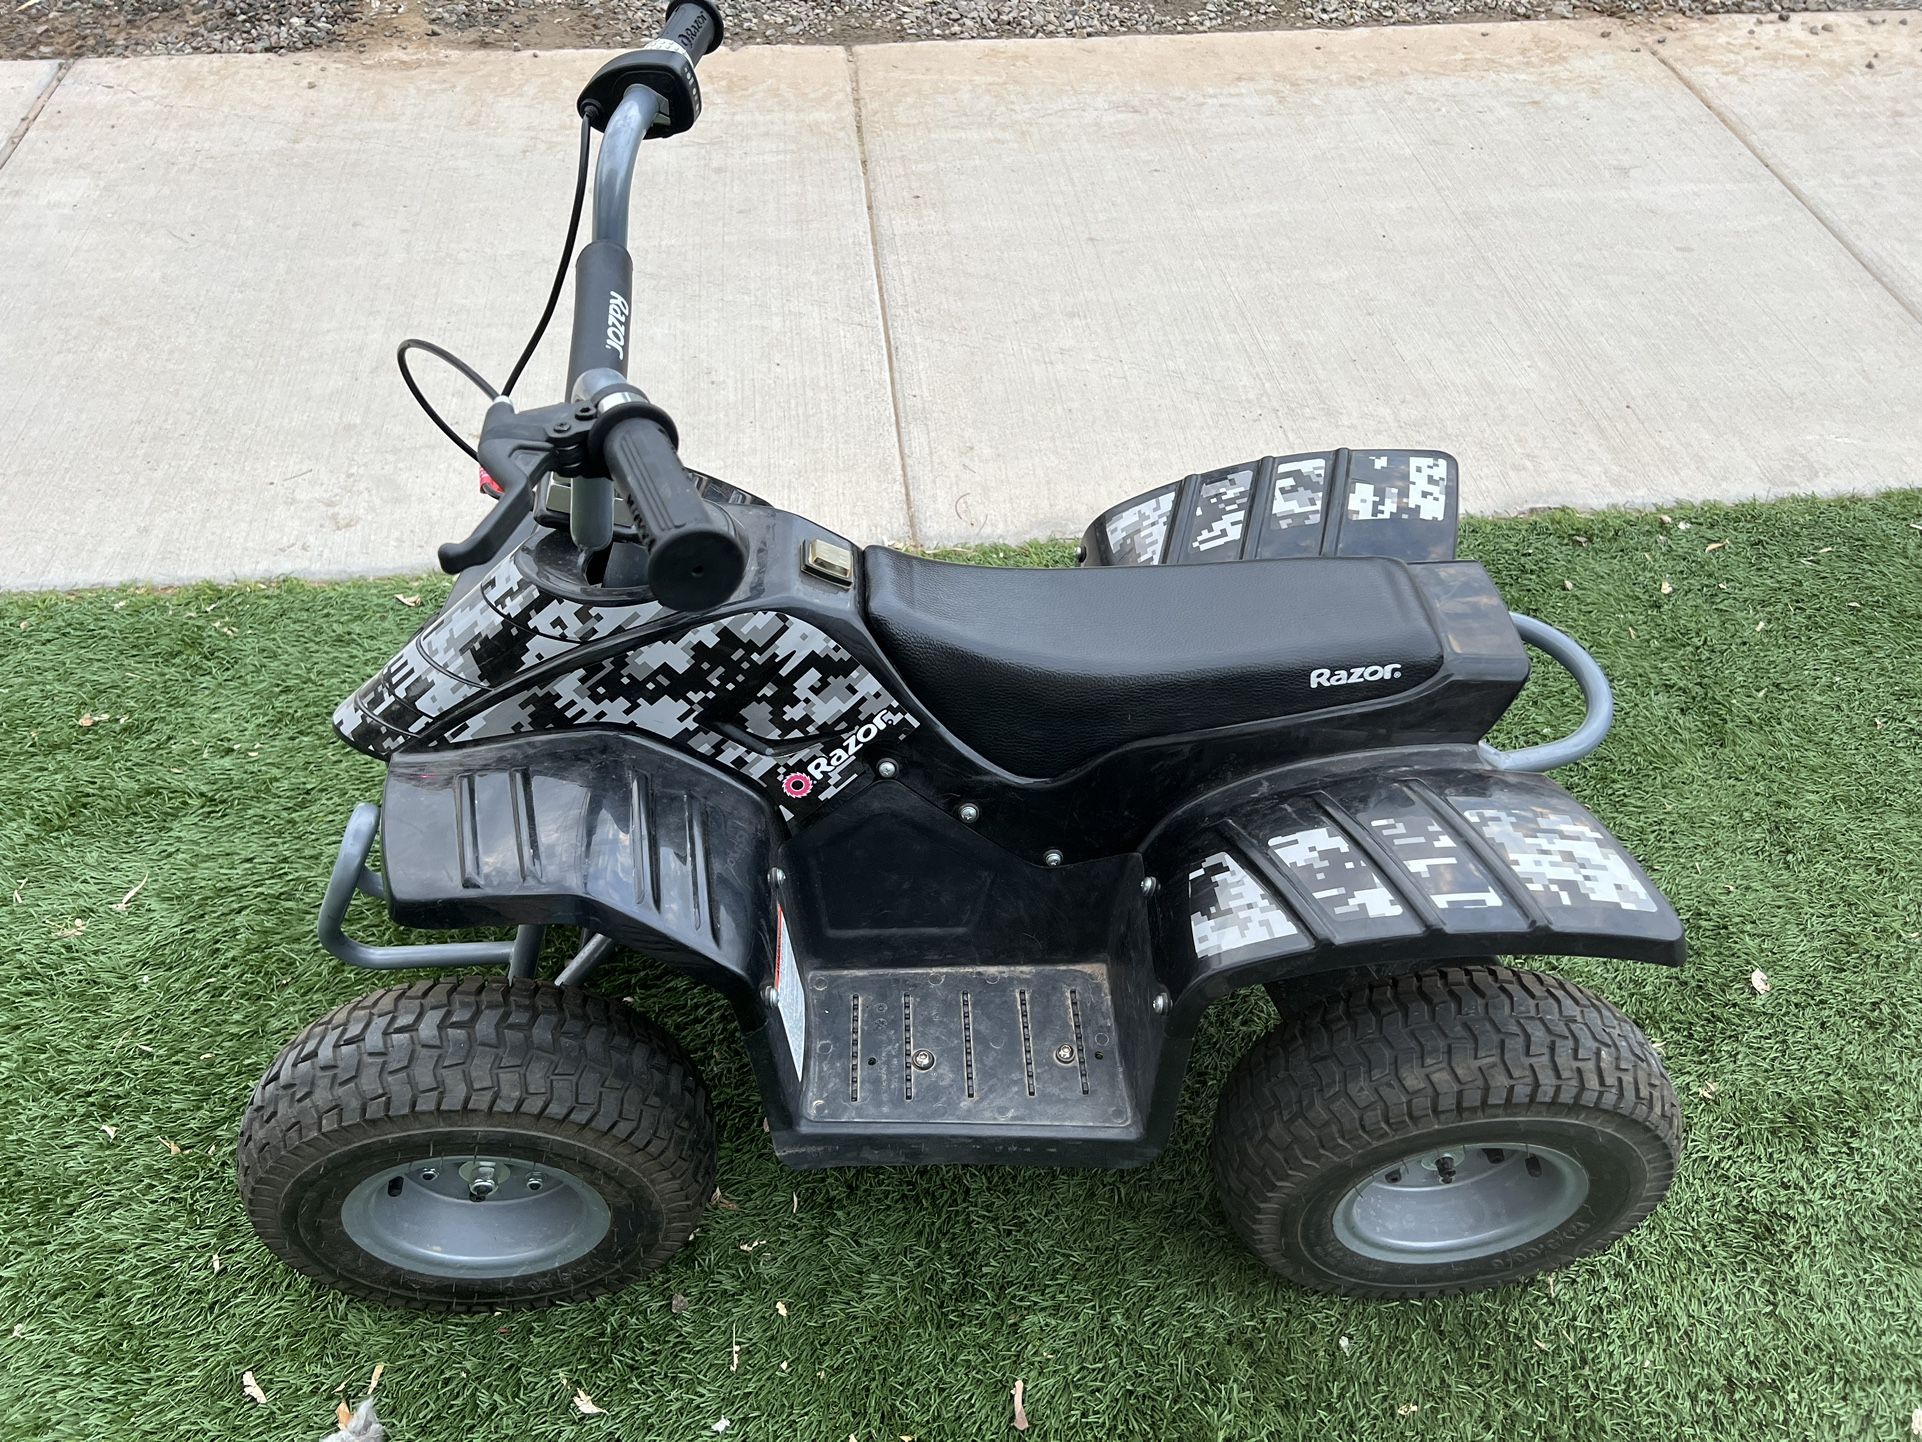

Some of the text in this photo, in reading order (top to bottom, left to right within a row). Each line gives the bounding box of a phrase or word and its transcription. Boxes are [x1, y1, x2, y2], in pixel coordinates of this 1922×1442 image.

[605, 290, 629, 361] Razor
[1310, 663, 1401, 689] Razor
[807, 709, 888, 780] Razor
